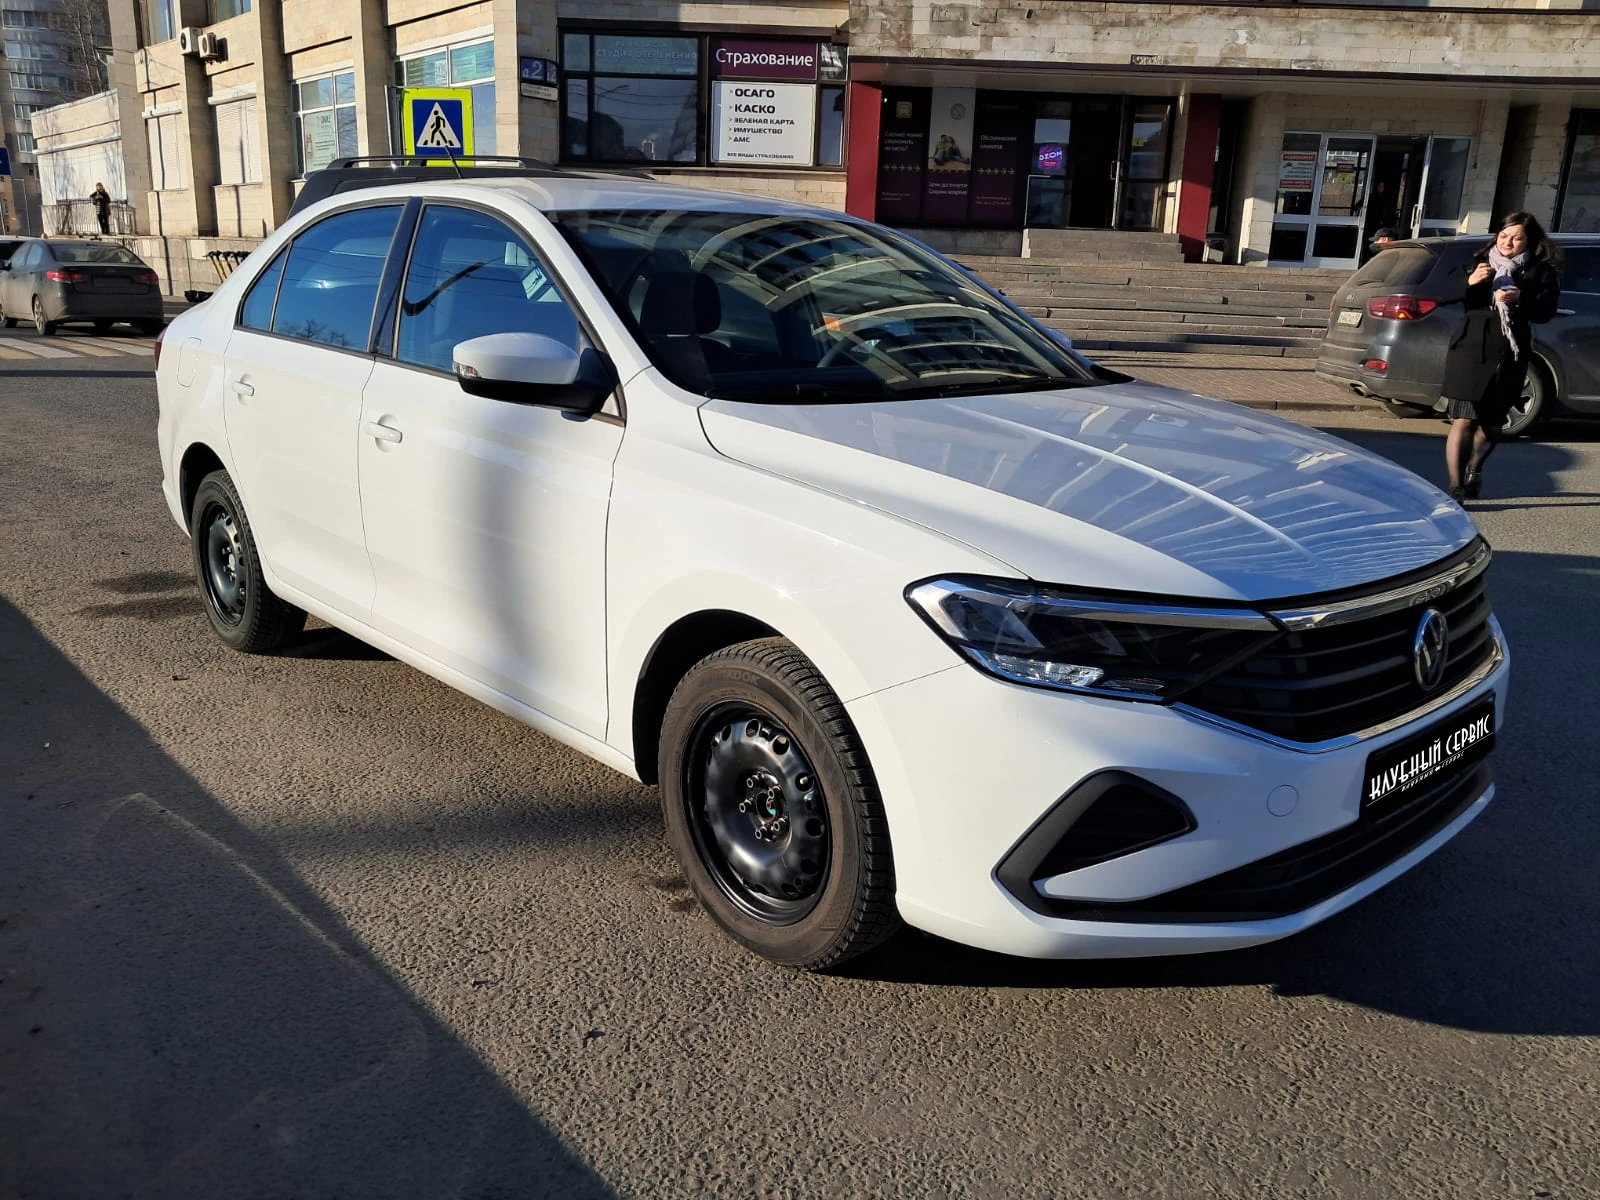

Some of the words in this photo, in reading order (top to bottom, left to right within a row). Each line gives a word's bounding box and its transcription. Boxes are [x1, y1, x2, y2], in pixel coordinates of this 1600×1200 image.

[715, 48, 814, 67] Страхование
[734, 88, 775, 98] ОСАГО
[734, 104, 776, 114] КАСКО
[733, 127, 783, 135] ИМУЩЕСТВО
